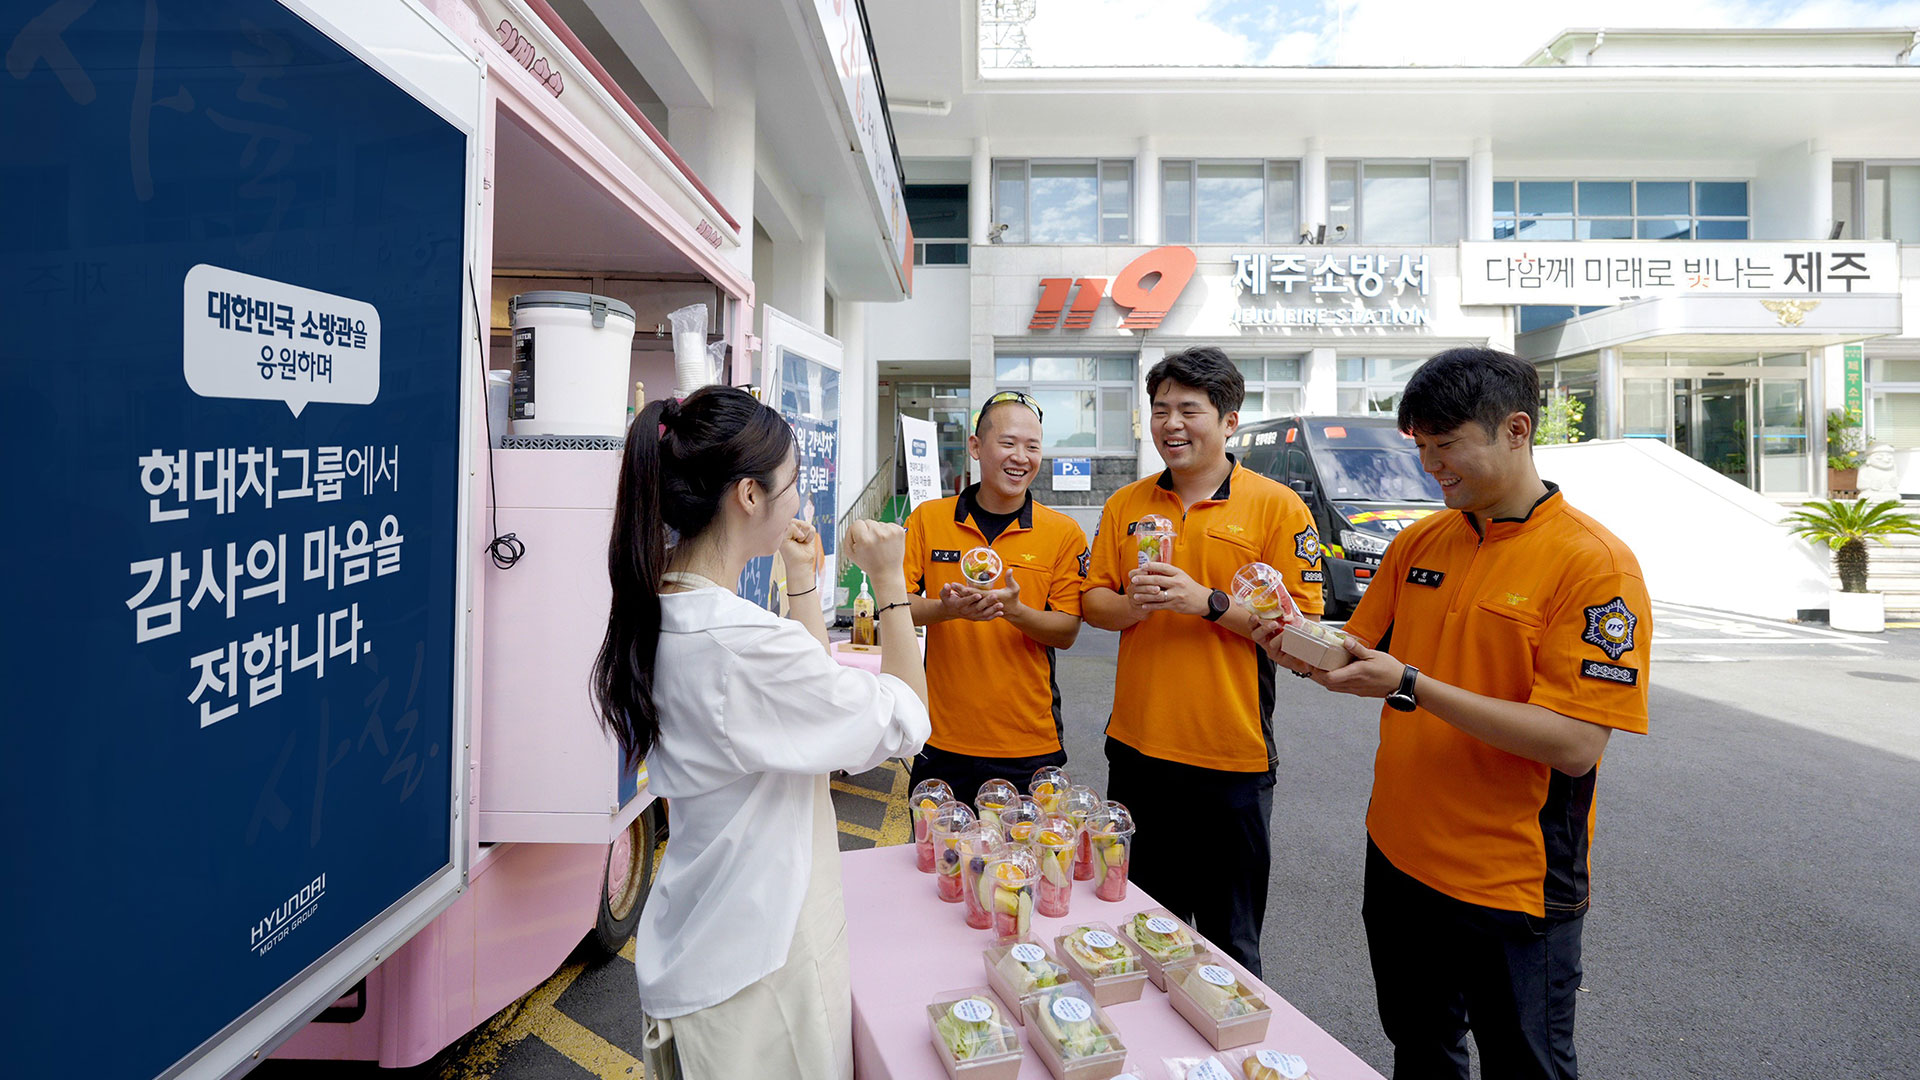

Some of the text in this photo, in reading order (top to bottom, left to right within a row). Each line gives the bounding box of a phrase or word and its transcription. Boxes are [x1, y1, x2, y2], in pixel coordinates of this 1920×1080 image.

[1028, 246, 1198, 329] 119
[1231, 254, 1430, 298] 제주소방서
[1486, 252, 1871, 293] 다함께 미래로 빛나는 제주
[207, 290, 368, 350] 대한민국 소방관을
[1285, 308, 1327, 325] FIRE
[1335, 308, 1428, 325] STATION
[256, 345, 333, 384] 응원하며
[138, 444, 399, 523] 현대차그룹에서
[1062, 462, 1073, 475] P
[125, 514, 404, 644] 감사의 마음을
[1607, 623, 1624, 632] 119
[187, 602, 372, 730] 전합니다.
[251, 872, 326, 945] HYUNDAI
[259, 903, 318, 957] MOTOR GROUP
